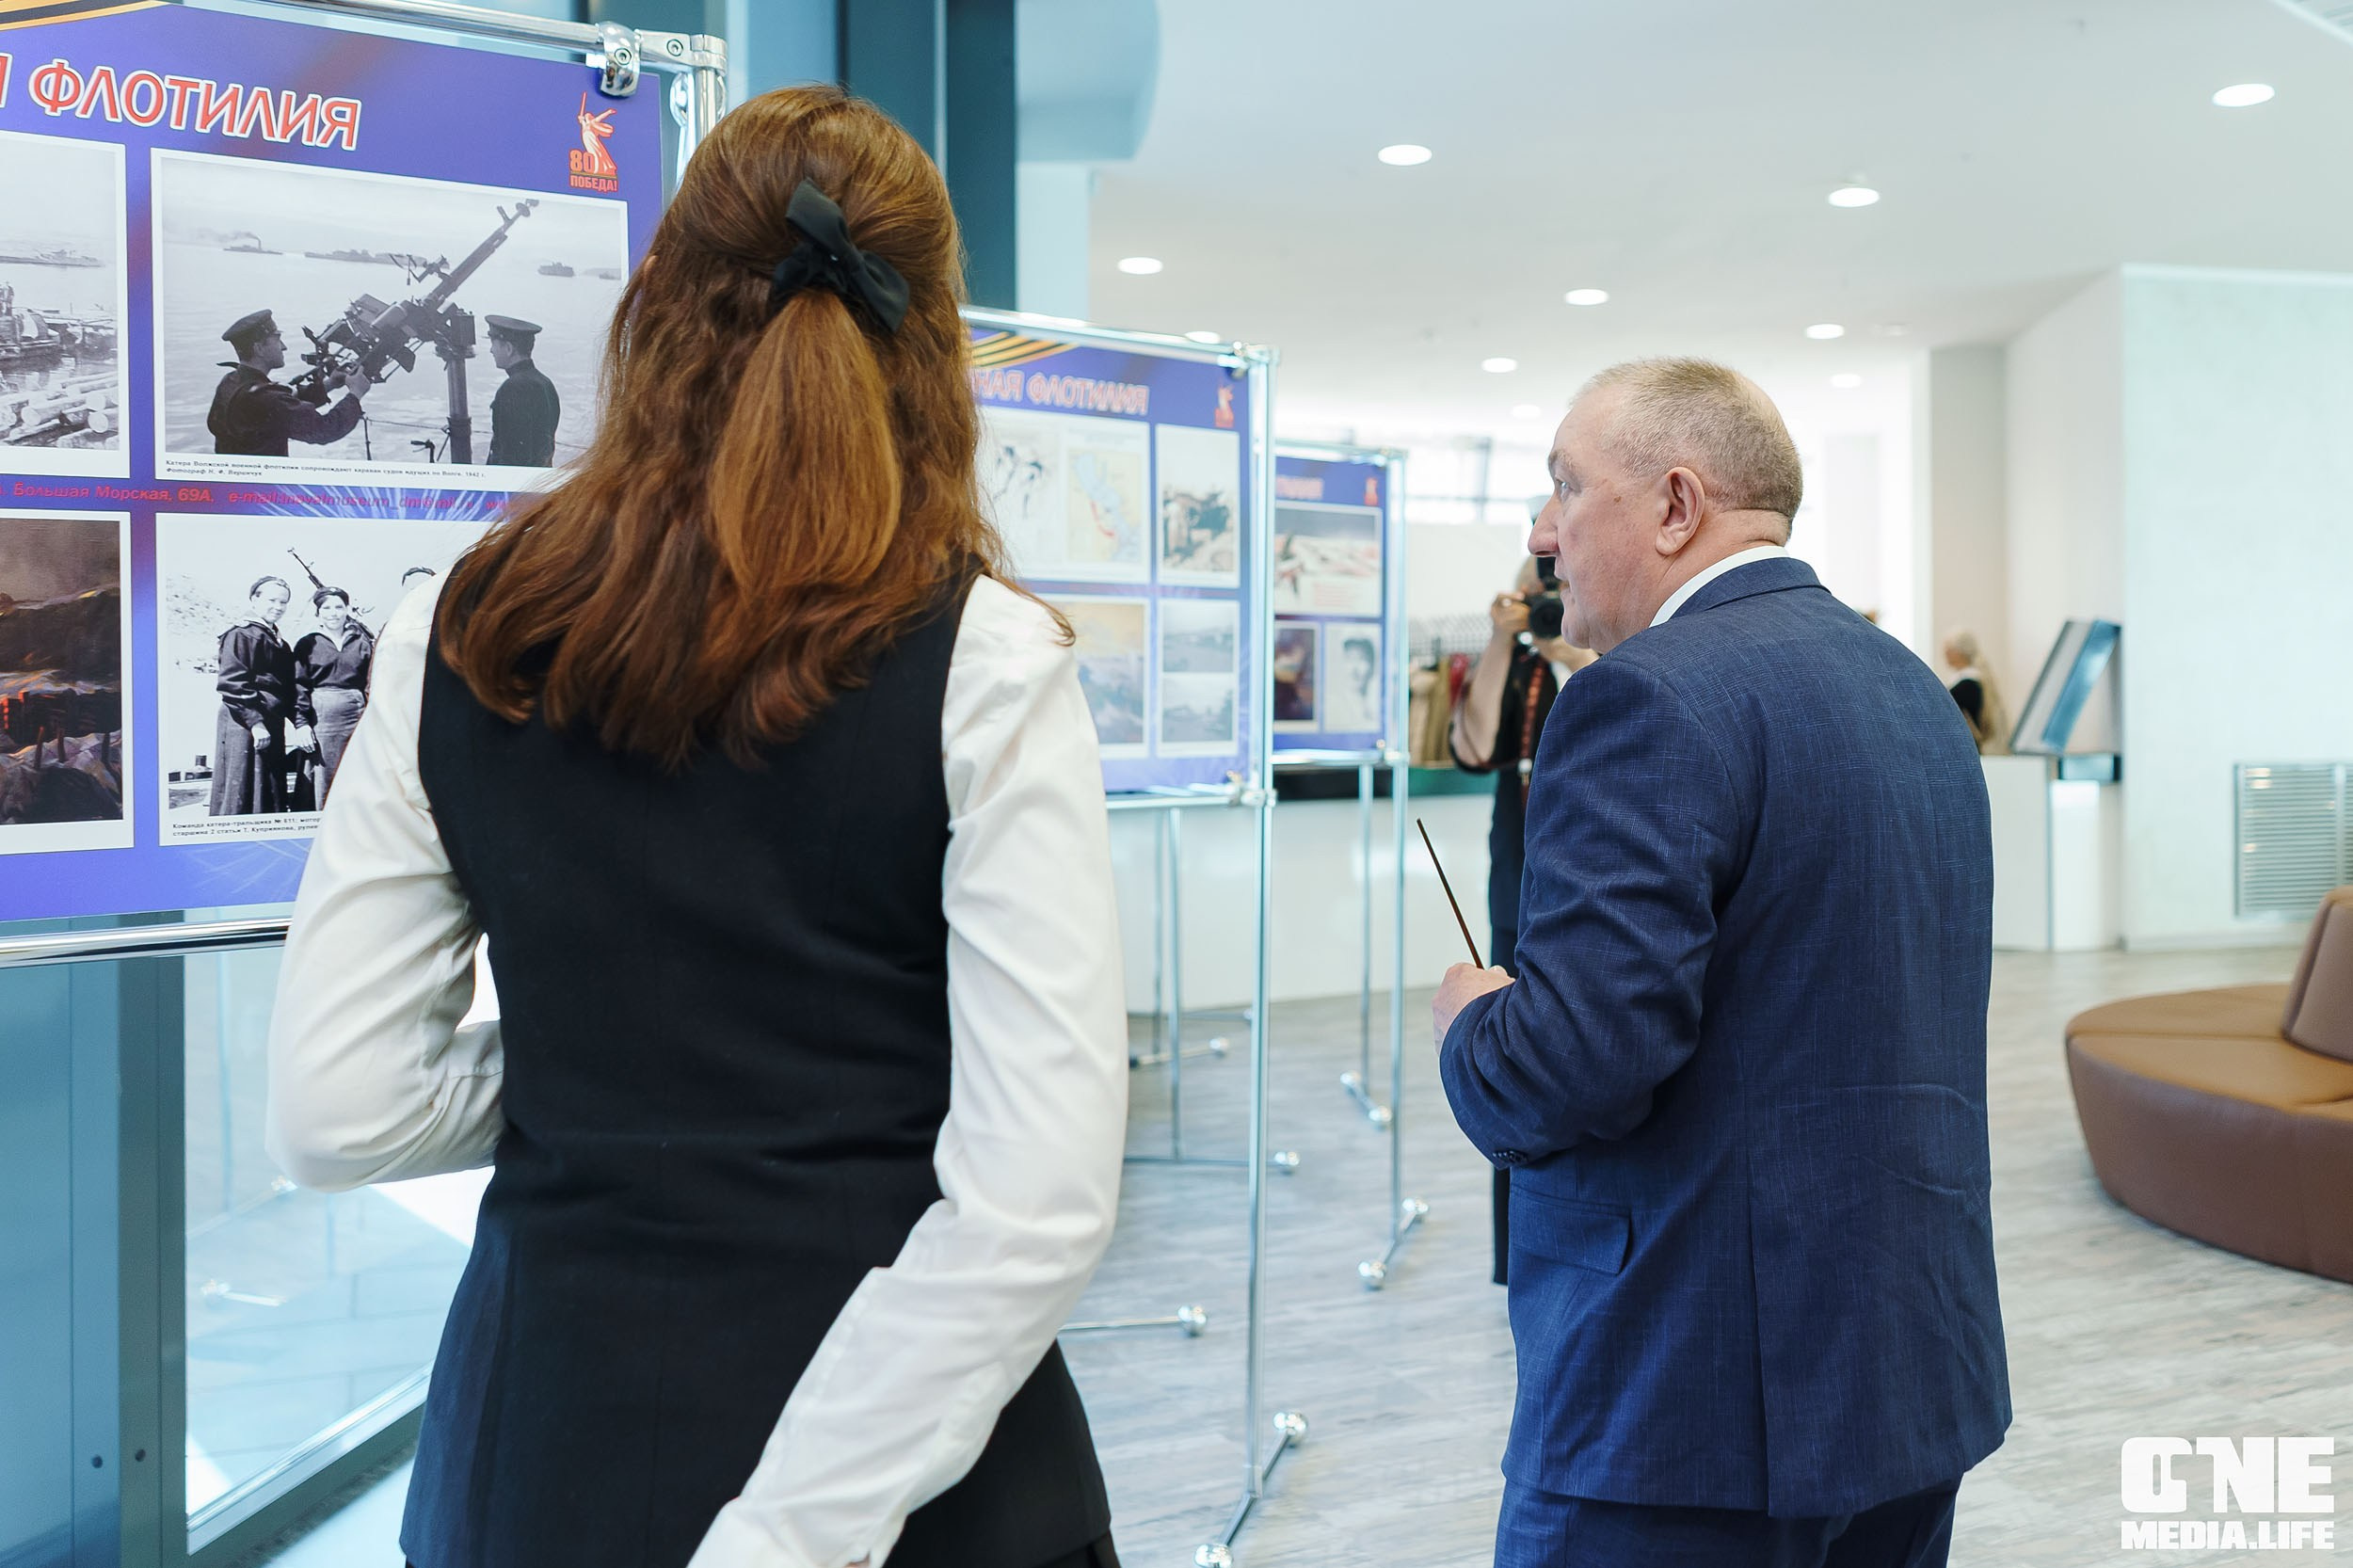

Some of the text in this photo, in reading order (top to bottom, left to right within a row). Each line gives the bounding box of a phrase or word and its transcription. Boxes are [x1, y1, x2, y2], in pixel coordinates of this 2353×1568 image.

[29, 59, 360, 150] ФЛОТИЛИЯ
[569, 150, 595, 173] 80
[569, 175, 618, 193] ПОБЕДА!
[13, 481, 90, 499] Большая
[95, 486, 172, 503] Морская,
